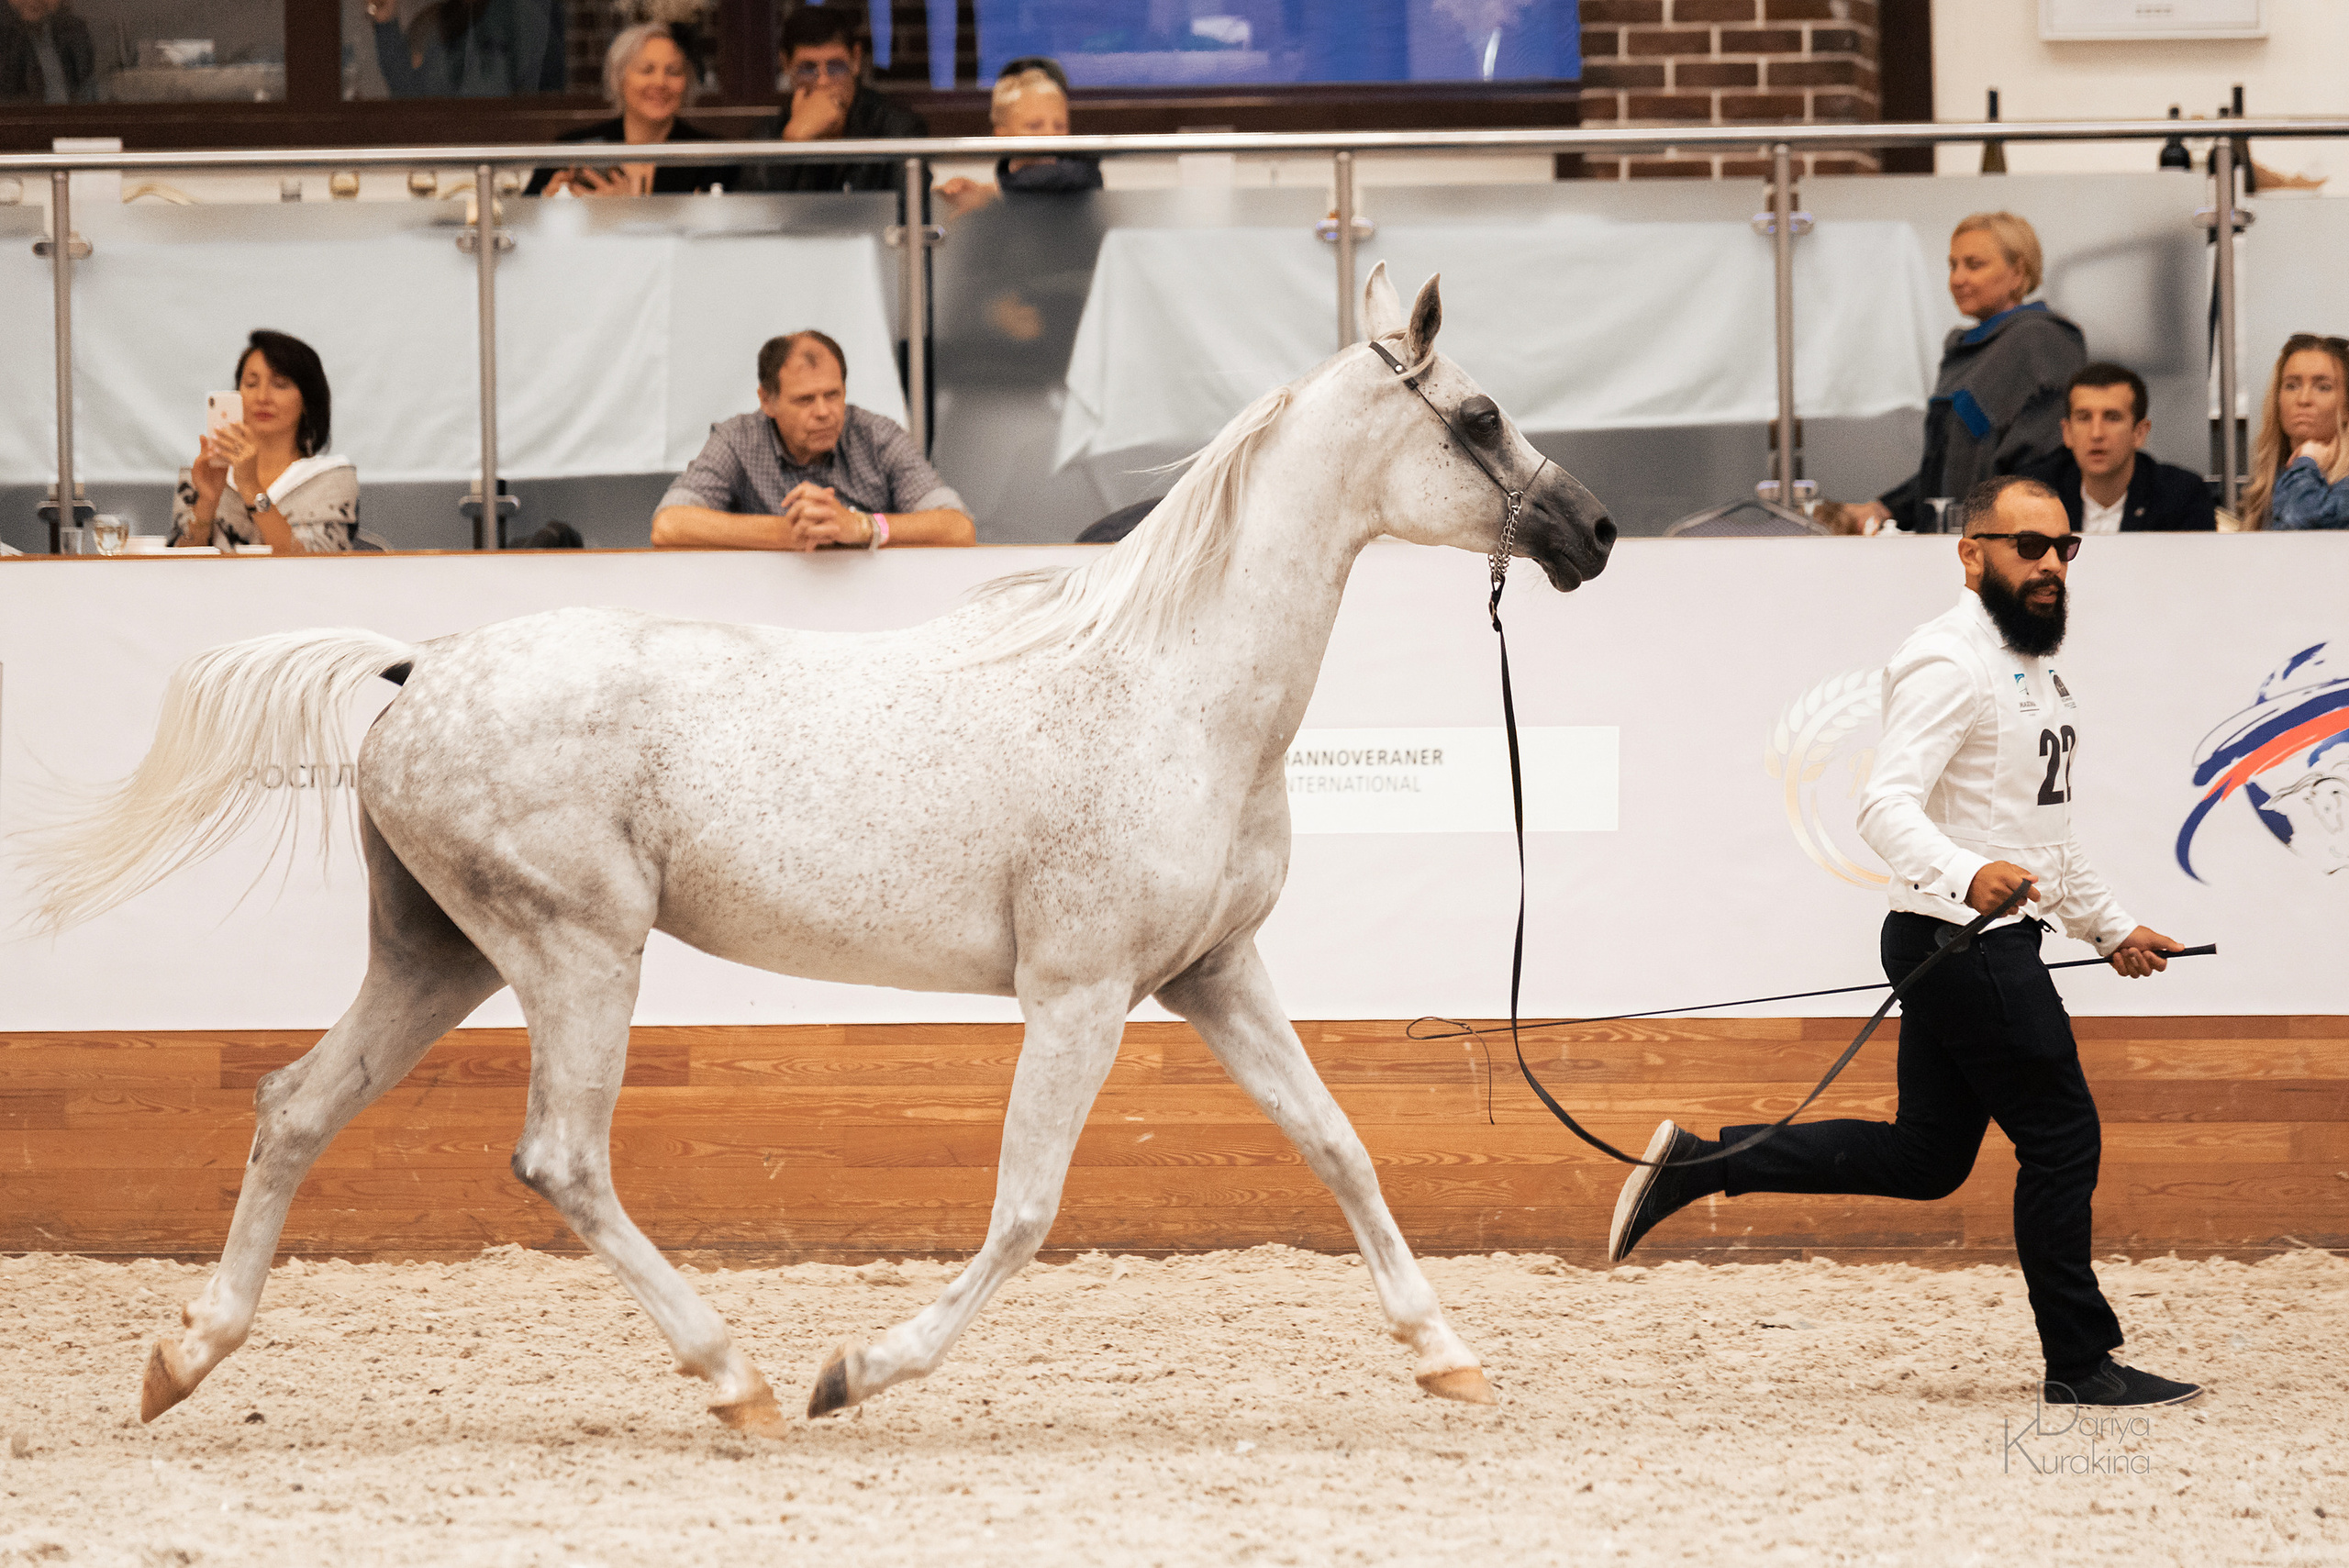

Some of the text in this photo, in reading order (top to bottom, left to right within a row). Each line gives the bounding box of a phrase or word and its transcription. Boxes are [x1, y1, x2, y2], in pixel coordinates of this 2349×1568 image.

[239, 763, 356, 790] РОСПЛ
[2037, 724, 2076, 806] 22
[1286, 774, 1422, 794] NTERNATIONAL
